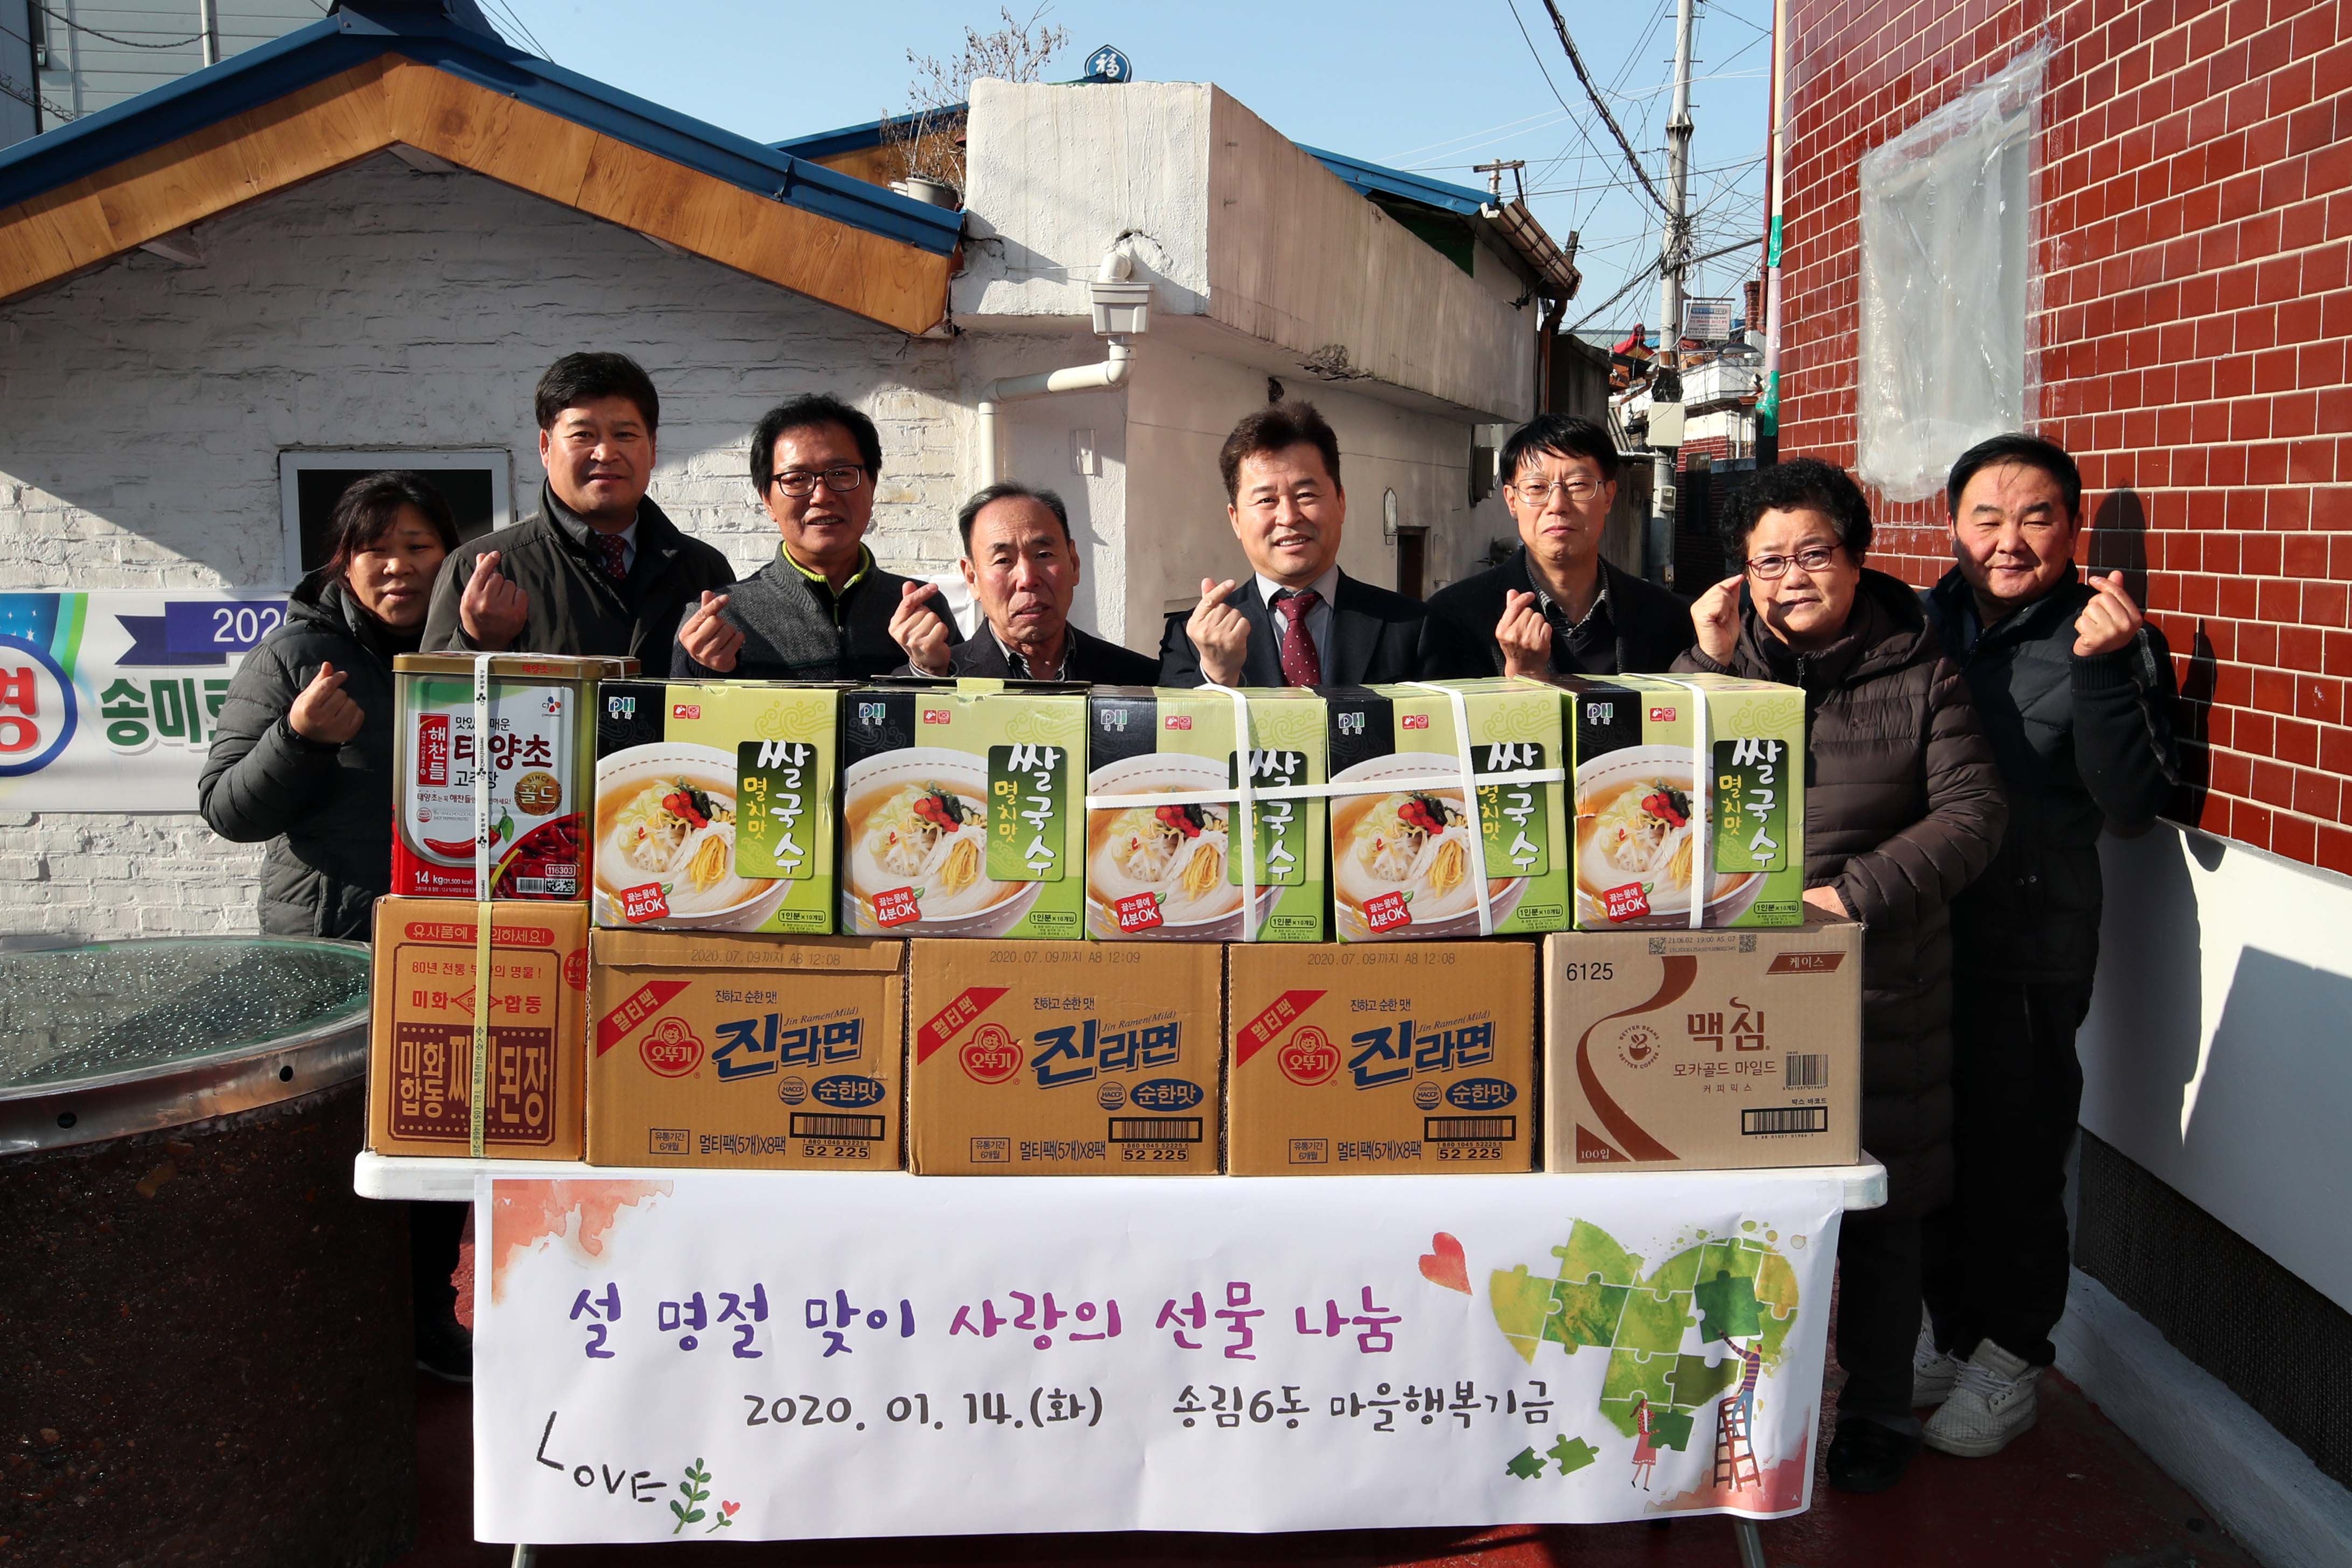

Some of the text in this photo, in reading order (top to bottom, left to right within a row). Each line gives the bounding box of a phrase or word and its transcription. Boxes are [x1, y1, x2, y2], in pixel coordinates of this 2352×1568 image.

[213, 608, 288, 642] 202
[456, 717, 510, 731] 맛있 매운
[428, 727, 446, 780] 해찬들
[527, 775, 551, 783] SINCE
[519, 784, 556, 804] 골드
[1732, 737, 1782, 867] 쌀국수
[744, 776, 767, 840] 멸치맛
[757, 738, 810, 874] 쌀국수
[994, 779, 1018, 843] 멸치맛
[1007, 742, 1060, 877] 쌀국수
[1719, 774, 1742, 836] 멸치맛
[415, 871, 429, 884] 14
[548, 866, 573, 875] 116303
[627, 898, 665, 917] 4분OK
[878, 901, 916, 921] 4분OK
[1609, 895, 1647, 916] 4분OK
[1121, 906, 1159, 926] 4분OK
[1370, 905, 1408, 927] 4분OK
[413, 925, 467, 940] 유사품에
[809, 954, 840, 965] 12:08
[1088, 952, 1102, 963] A8
[1109, 951, 1140, 963] 12:09
[1405, 954, 1418, 964] A8
[1424, 953, 1455, 964] 12:08
[1789, 956, 1825, 969] 케이스
[412, 962, 437, 974] 80년
[443, 963, 465, 976] 전통
[1566, 962, 1613, 982] 6125
[413, 990, 542, 1014] 미화 합동
[716, 990, 742, 1002] 진하고
[745, 991, 764, 1003] 순한
[1033, 998, 1060, 1010] 진하고
[1062, 997, 1081, 1010] 순한
[1350, 999, 1377, 1011] 진하고
[1379, 999, 1398, 1012] 순한
[612, 989, 659, 1032] 멀티팩
[784, 1006, 859, 1026] Jin Ramen(Mild)
[931, 997, 978, 1039] 멀티팩
[1102, 1010, 1176, 1032] Jin Ramen(Mild)
[1250, 999, 1296, 1042] 멀티팩
[1419, 1010, 1490, 1033] Jin Ramen(Mild)
[1687, 997, 1767, 1052] 맥심
[1619, 1025, 1660, 1040] BETTER BEANS
[651, 1045, 692, 1063] 오뚜기
[711, 1013, 864, 1082] 진라면
[1031, 1018, 1181, 1090] 진라면
[1348, 1020, 1496, 1090] 진라면
[401, 1041, 445, 1079] 미화
[970, 1052, 1011, 1069] 오뚜기
[1290, 1054, 1329, 1071] 오뚜기
[1619, 1052, 1660, 1069] BETTER COFFEE
[1673, 1060, 1777, 1076] 모카골드 마일드
[401, 1077, 444, 1118] 합동
[818, 1081, 878, 1102] 순한맛
[1137, 1085, 1195, 1104] 순한맛
[1452, 1084, 1509, 1103] 순한맛
[655, 1132, 685, 1142] 유통기간
[660, 1142, 680, 1151] 6개월
[975, 1140, 1005, 1150] 유통기간
[805, 1146, 868, 1157] 52 225
[981, 1150, 1000, 1159] 6개월
[1124, 1150, 1187, 1160] 52 225
[1293, 1143, 1322, 1151] 유통기간
[1299, 1152, 1318, 1160] 6개월
[1439, 1148, 1500, 1159] 52 225
[1580, 1149, 1609, 1159] 100입
[569, 1282, 1402, 1361] 설 명절 맞이 사랑의 선물 나눔
[744, 1394, 866, 1431] 2020.
[886, 1393, 943, 1430] 01.
[1173, 1380, 1555, 1433] 송림6동 마을행복기금
[535, 1410, 668, 1502] LOVE
